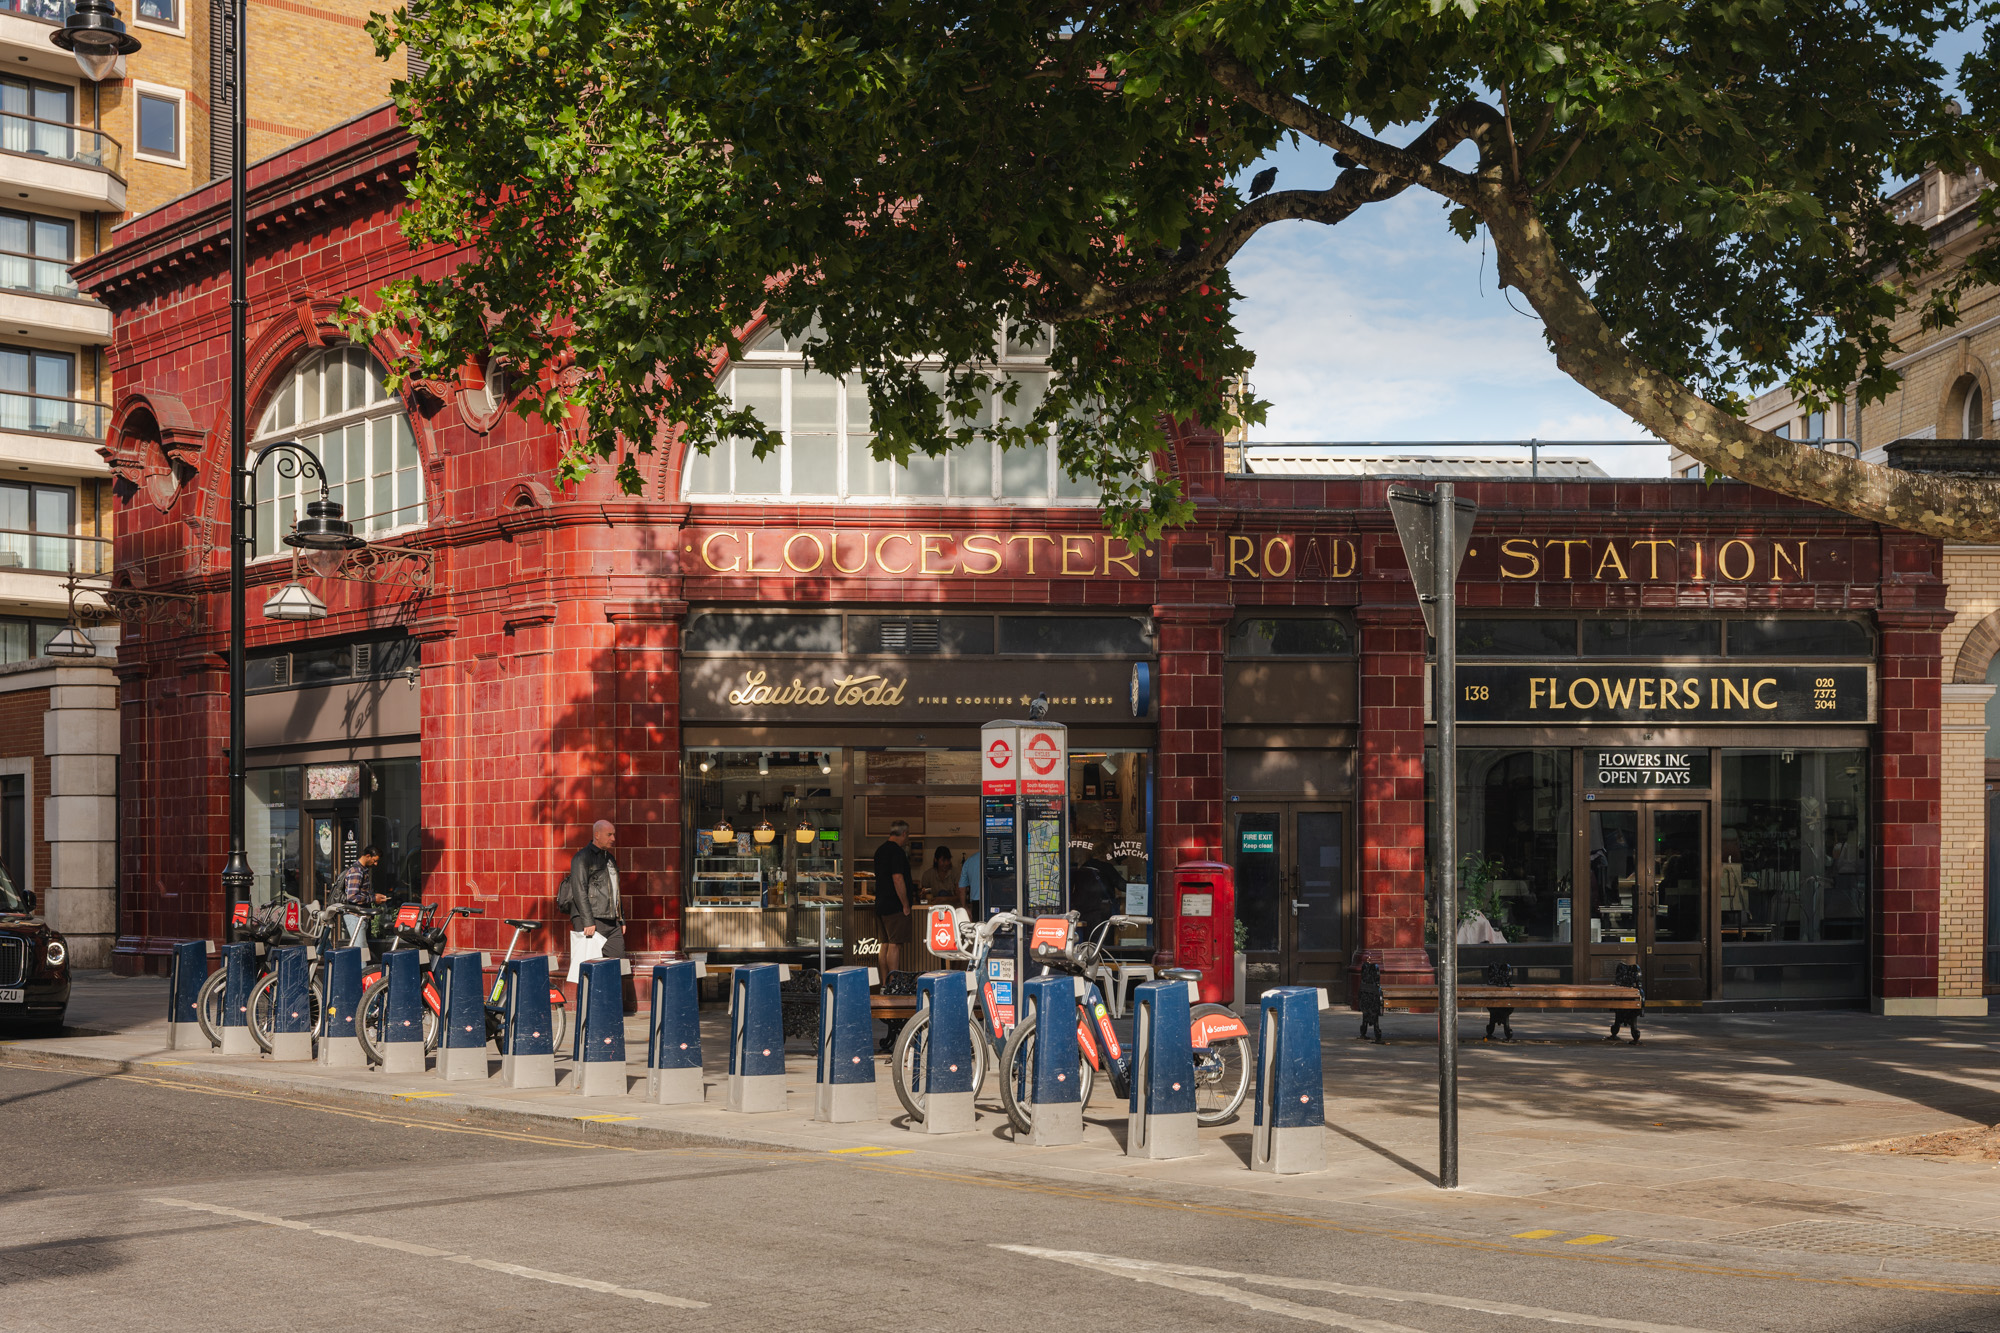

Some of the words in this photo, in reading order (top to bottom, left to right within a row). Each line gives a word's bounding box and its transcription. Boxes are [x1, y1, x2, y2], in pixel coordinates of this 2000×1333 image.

[702, 531, 1139, 577] GLOUCESTER
[1228, 535, 1357, 579] ROAD
[1500, 538, 1805, 583] STATION
[728, 670, 829, 706] Laura
[1815, 678, 1835, 688] 020
[1464, 685, 1490, 701] 138
[1529, 677, 1699, 710] FLOWERS
[1710, 677, 1778, 710] INC
[1814, 688, 1837, 699] 7373
[918, 697, 948, 705] FINE
[955, 697, 1013, 705] COOKIES
[1047, 697, 1077, 705] INCE
[1814, 700, 1837, 710] 3041
[1598, 753, 1661, 767] FLOWERS
[1664, 753, 1691, 767] INC
[1598, 771, 1638, 785] OPEN
[1641, 771, 1650, 784] 7
[1655, 771, 1691, 785] DAYS
[1114, 841, 1142, 849] LATTE
[1114, 849, 1149, 861] MATCHA
[992, 963, 998, 976] P
[1213, 1024, 1238, 1032] Santander
[1080, 1034, 1096, 1058] Santander
